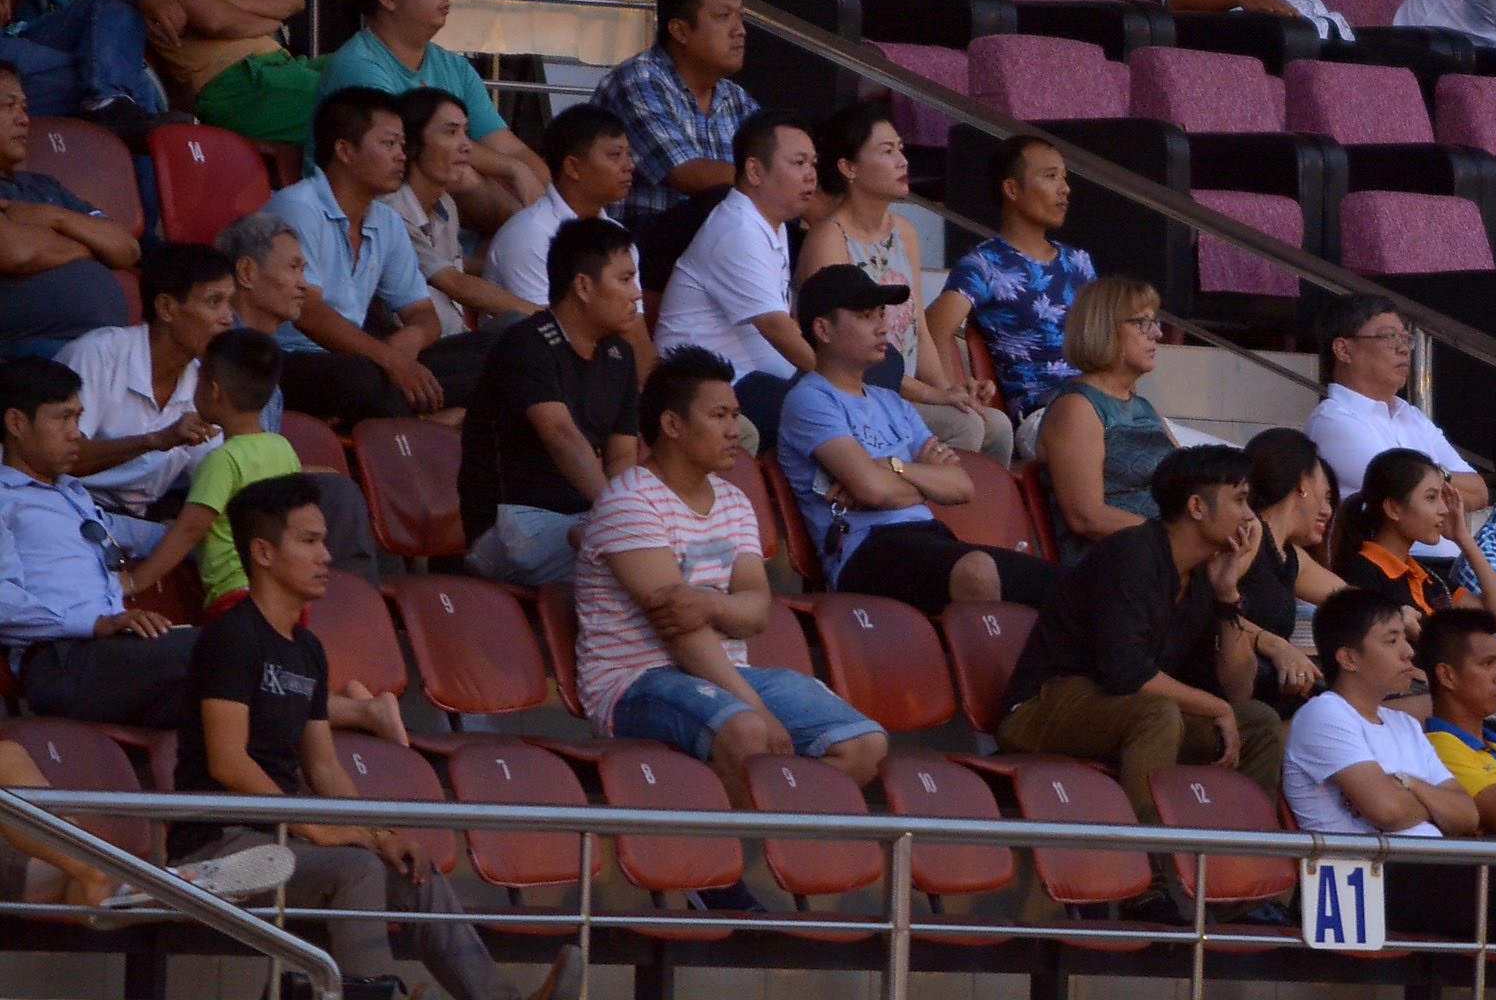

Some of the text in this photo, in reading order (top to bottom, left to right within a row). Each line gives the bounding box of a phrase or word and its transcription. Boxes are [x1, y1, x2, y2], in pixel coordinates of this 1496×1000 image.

[48, 132, 66, 153] 13
[188, 141, 205, 162] 14
[395, 434, 411, 456] 11
[439, 593, 454, 613] 9
[852, 609, 874, 628] 12
[982, 615, 1001, 636] 13
[352, 753, 368, 775] 6
[640, 763, 656, 784] 8
[782, 767, 797, 787] 9
[918, 772, 937, 793] 10
[1052, 781, 1069, 803] 11
[1190, 783, 1211, 803] 12
[1315, 865, 1366, 943] A1
